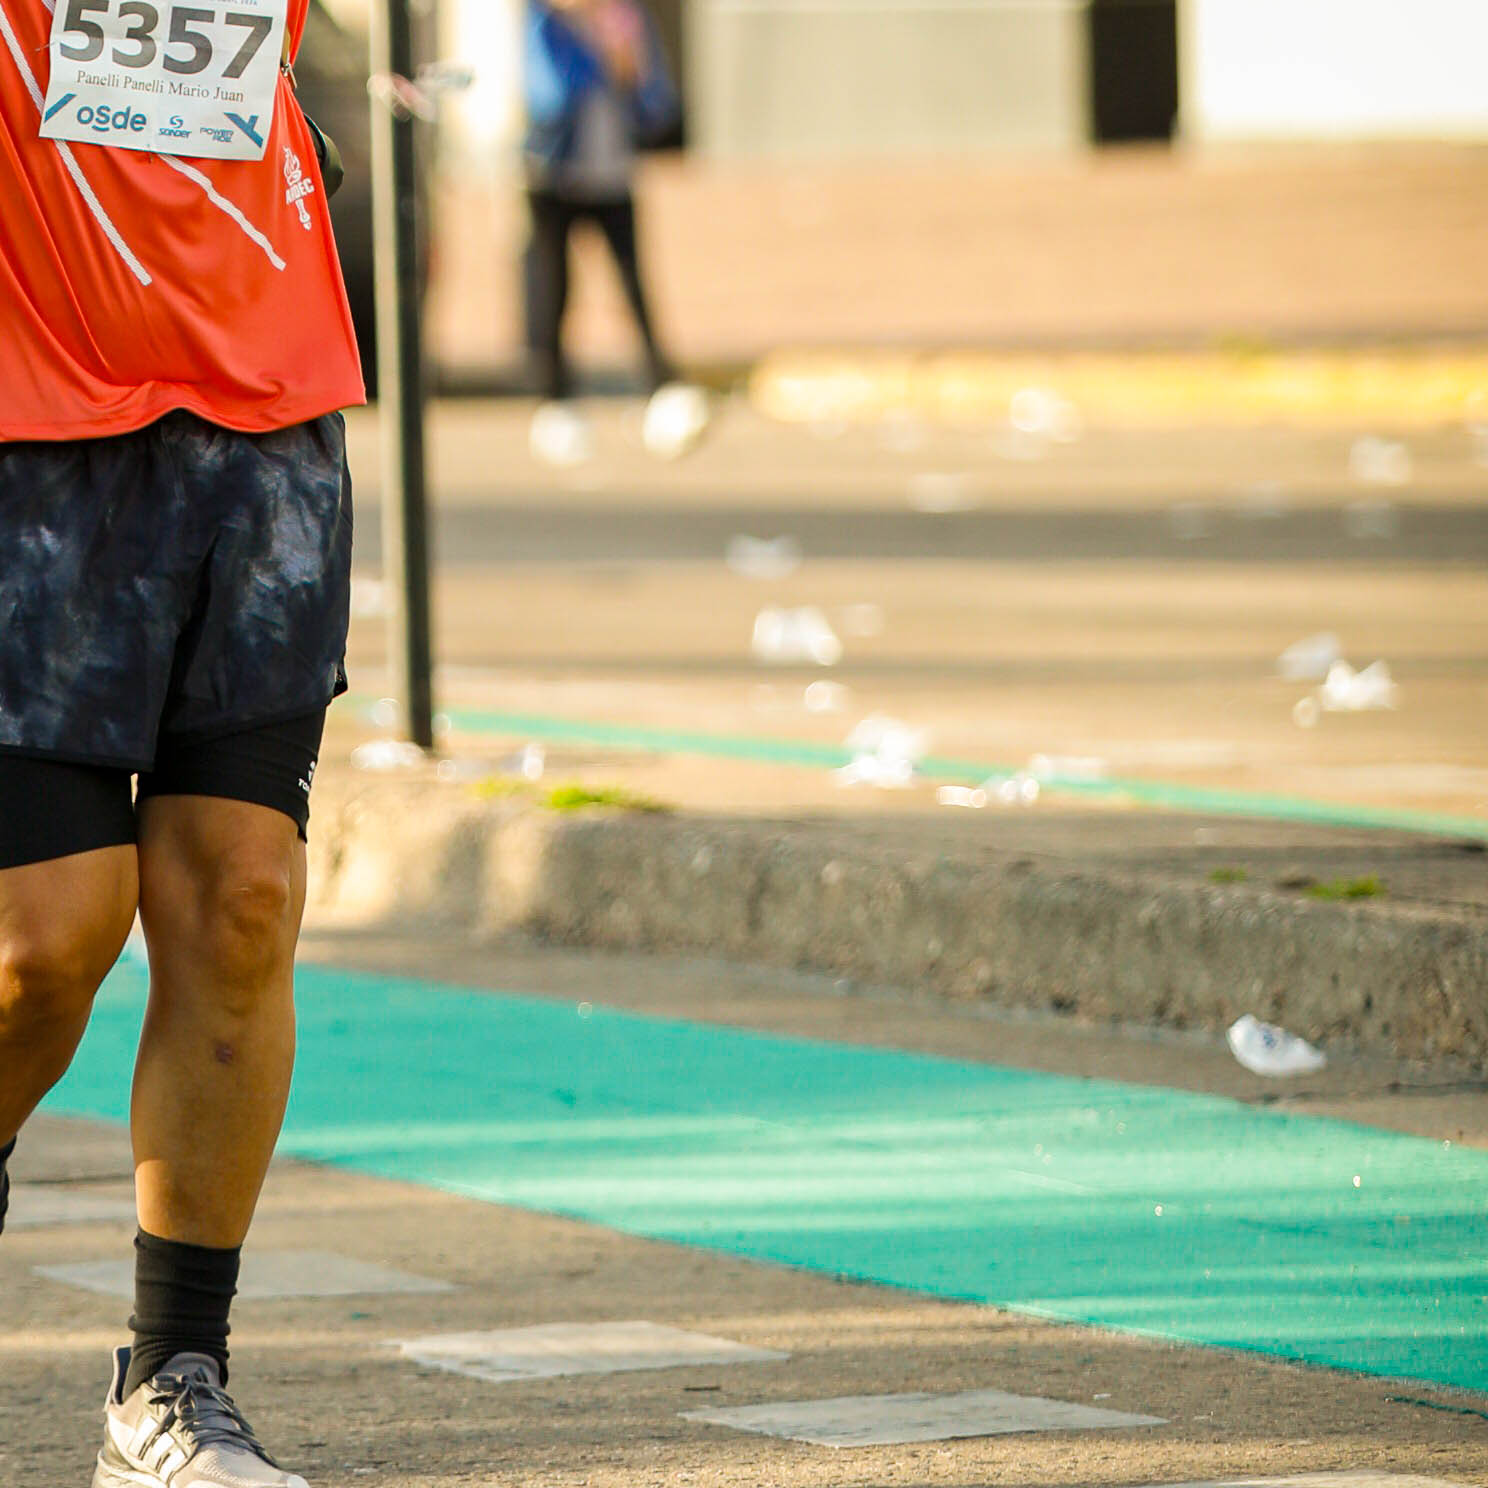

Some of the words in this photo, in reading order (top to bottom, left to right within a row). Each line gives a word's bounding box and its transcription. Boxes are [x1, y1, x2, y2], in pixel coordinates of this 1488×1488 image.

[77, 70, 119, 87] Panelli
[123, 76, 164, 93] Panelli
[168, 81, 209, 98] Mario
[213, 86, 244, 103] Juan
